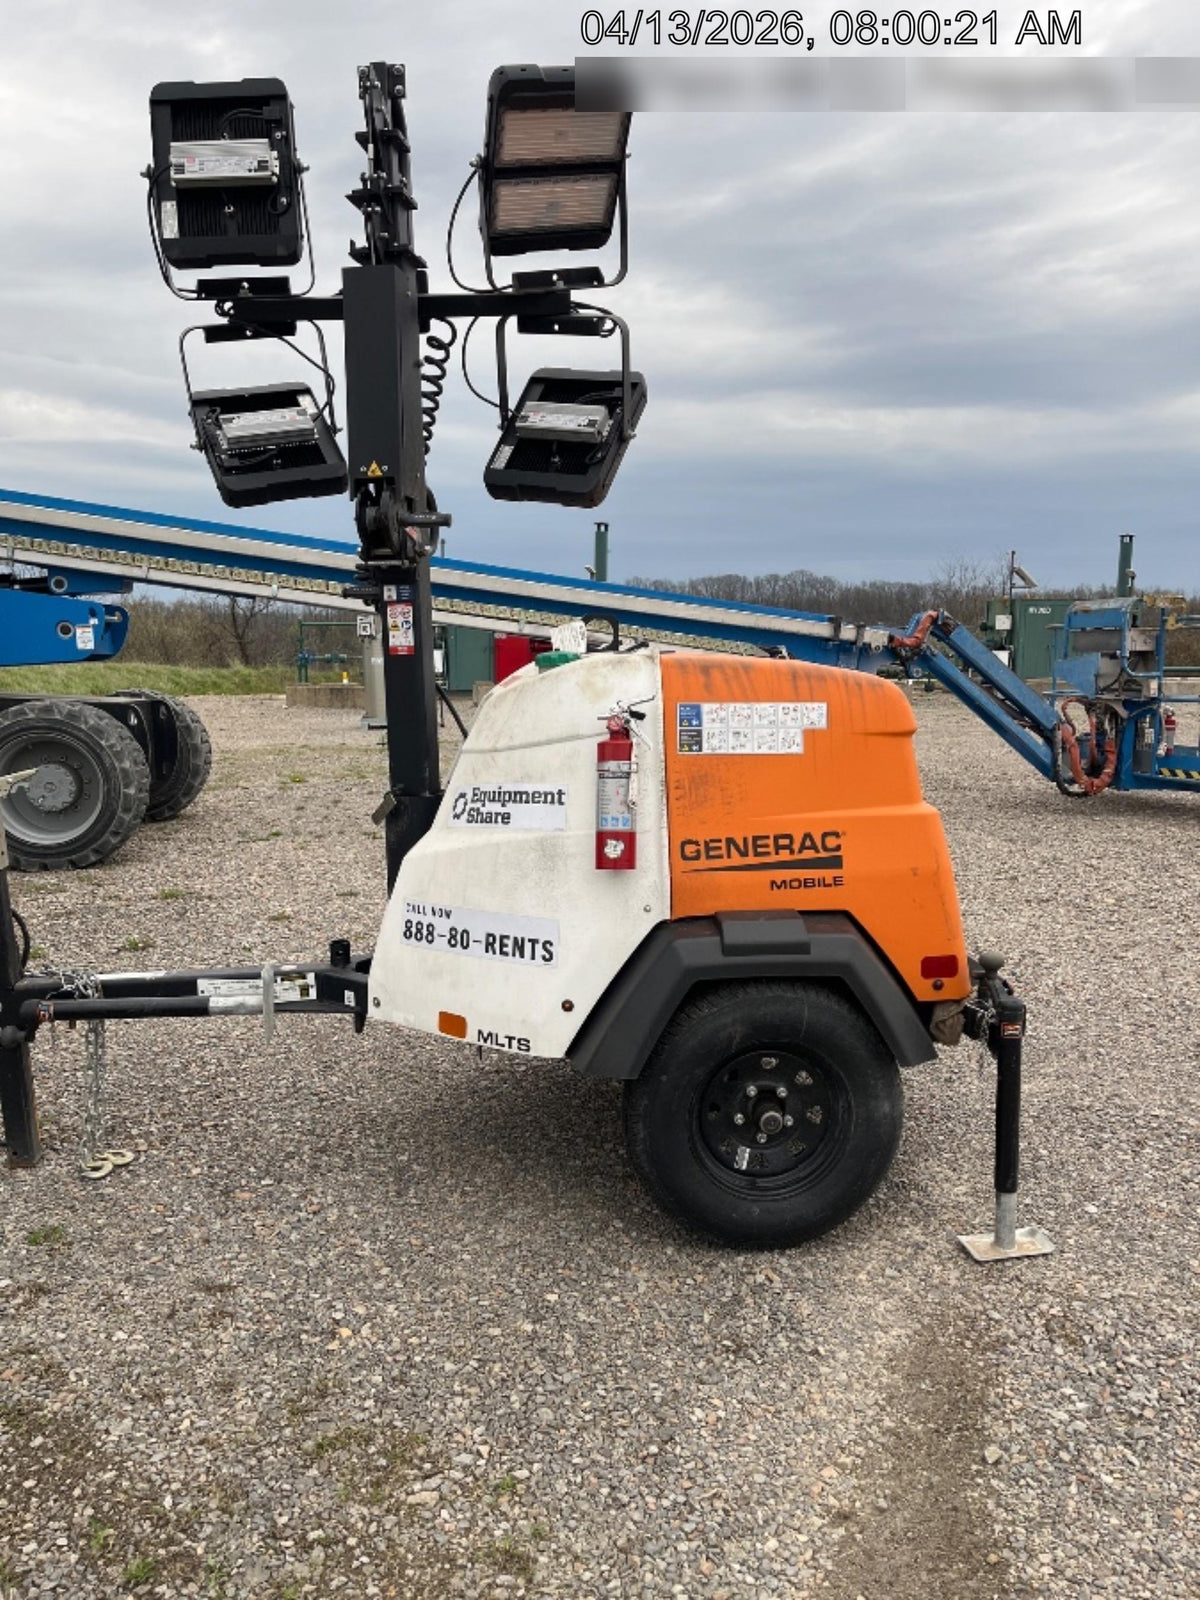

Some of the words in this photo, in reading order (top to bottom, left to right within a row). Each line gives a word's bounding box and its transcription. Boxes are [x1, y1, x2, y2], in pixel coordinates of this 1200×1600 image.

[471, 786, 566, 808] Equipment
[466, 807, 511, 825] Share
[679, 831, 842, 862] GENERAC
[769, 876, 844, 891] MOBILE
[431, 906, 452, 919] NOW
[403, 918, 554, 963] 888-80-RENTS
[477, 1029, 531, 1053] MLTS
